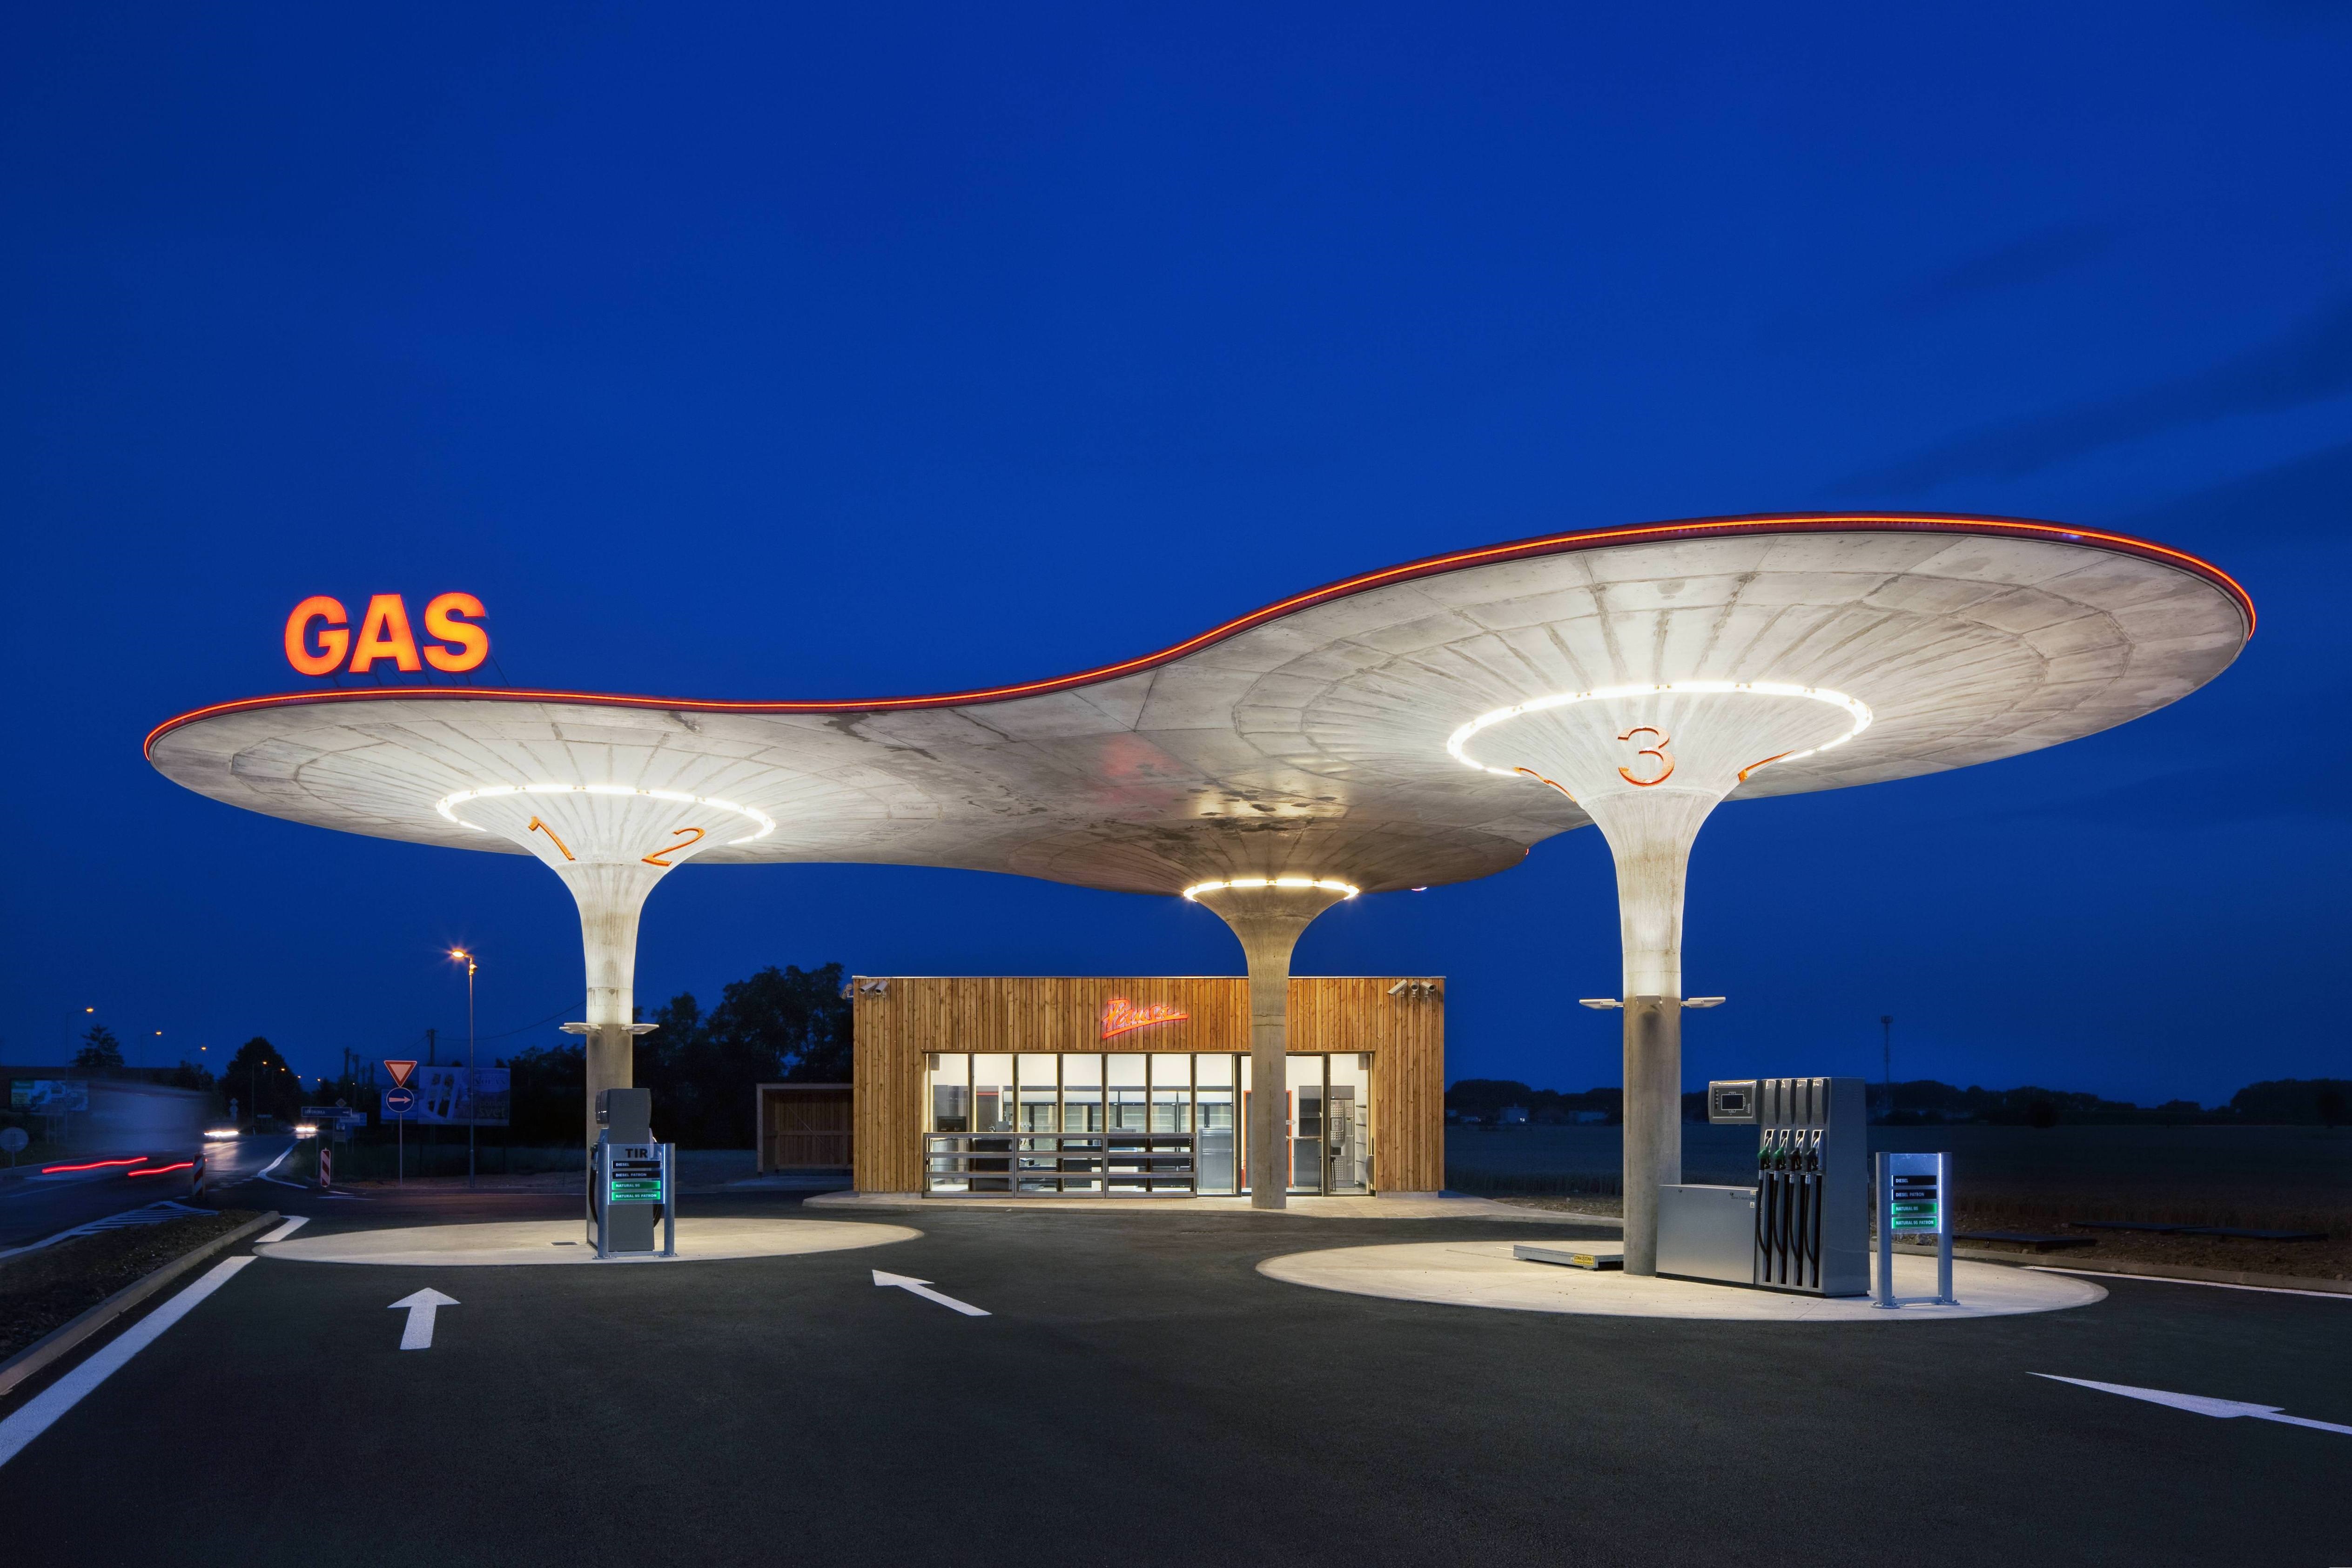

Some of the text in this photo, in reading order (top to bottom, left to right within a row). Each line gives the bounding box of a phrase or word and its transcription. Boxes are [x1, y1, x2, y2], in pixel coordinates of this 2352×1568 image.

[284, 592, 489, 676] GAS
[1617, 725, 1675, 787] 3
[528, 815, 576, 861] 1
[641, 827, 706, 867] 2
[1102, 998, 1189, 1039] Pausa
[625, 1148, 648, 1158] TIR
